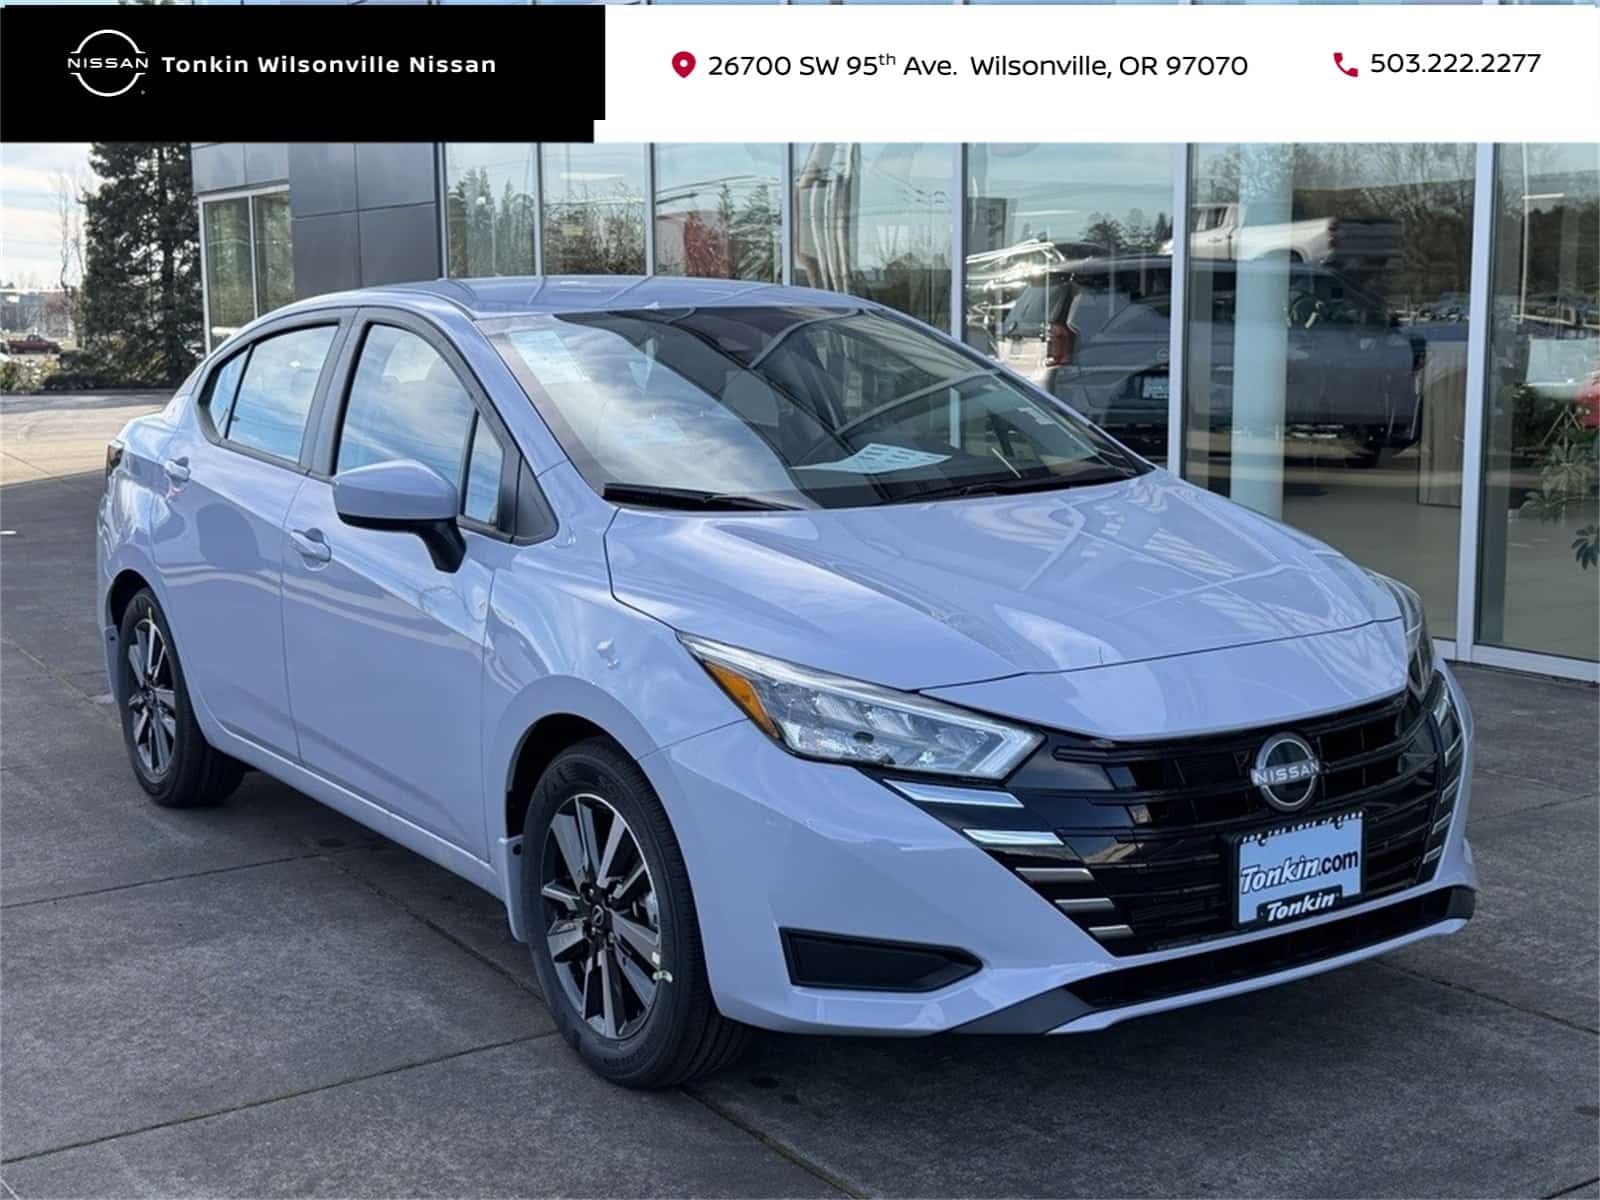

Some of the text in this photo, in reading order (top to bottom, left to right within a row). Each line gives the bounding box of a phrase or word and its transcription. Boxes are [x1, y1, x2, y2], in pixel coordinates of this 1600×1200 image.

[1254, 759, 1320, 785] NISSAN
[1240, 849, 1359, 895] Tonkin.com
[1266, 891, 1336, 922] Tonkin
